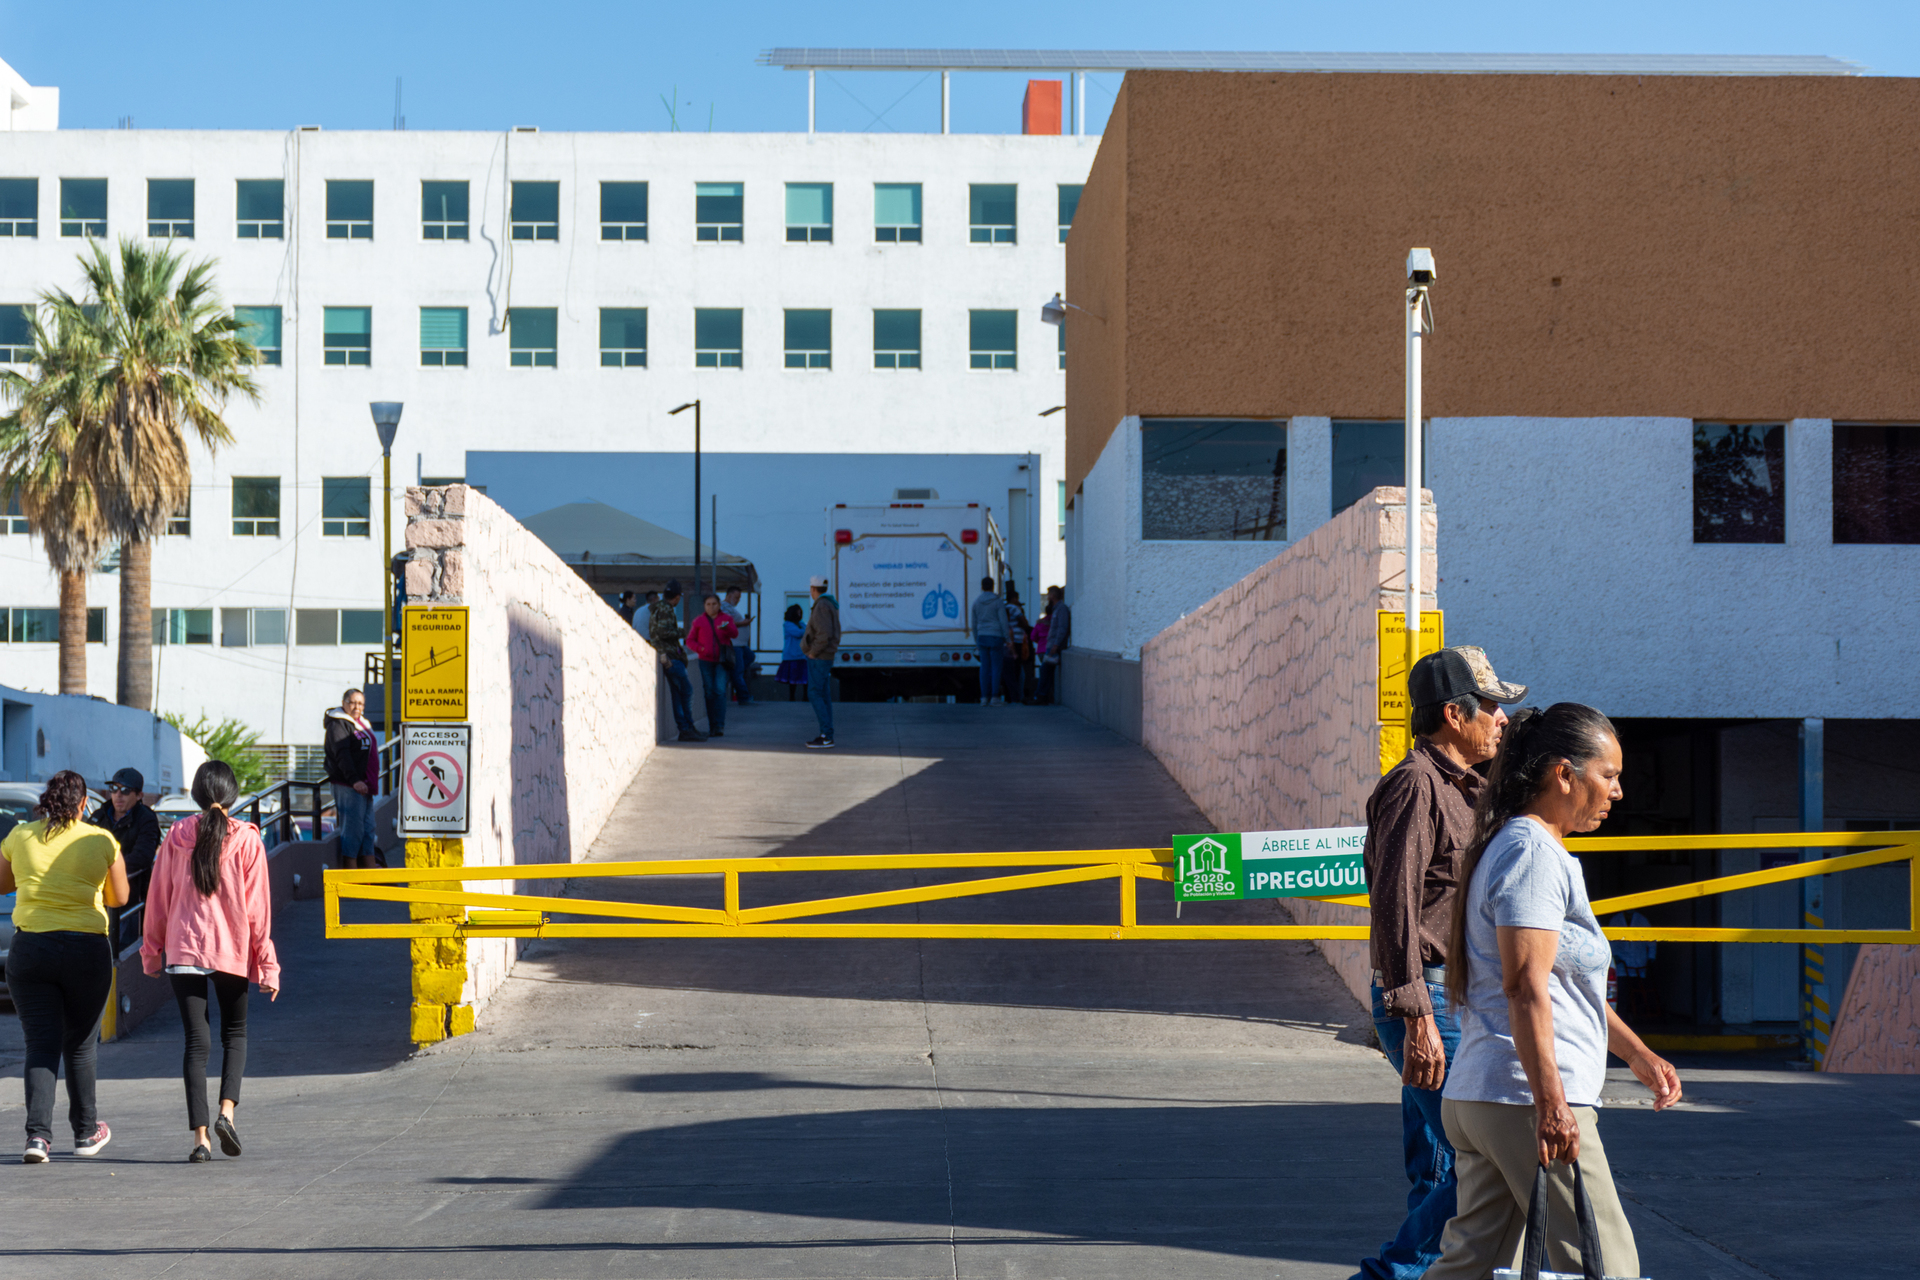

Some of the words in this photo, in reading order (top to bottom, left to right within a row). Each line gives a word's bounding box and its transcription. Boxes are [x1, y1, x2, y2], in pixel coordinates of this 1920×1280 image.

[905, 561, 929, 569] MÓVIL
[409, 698, 464, 706] PEATONAL
[1261, 837, 1310, 853] ÁBRELE
[1315, 837, 1332, 849] AL
[1193, 873, 1224, 883] 2020
[1183, 881, 1235, 893] censo
